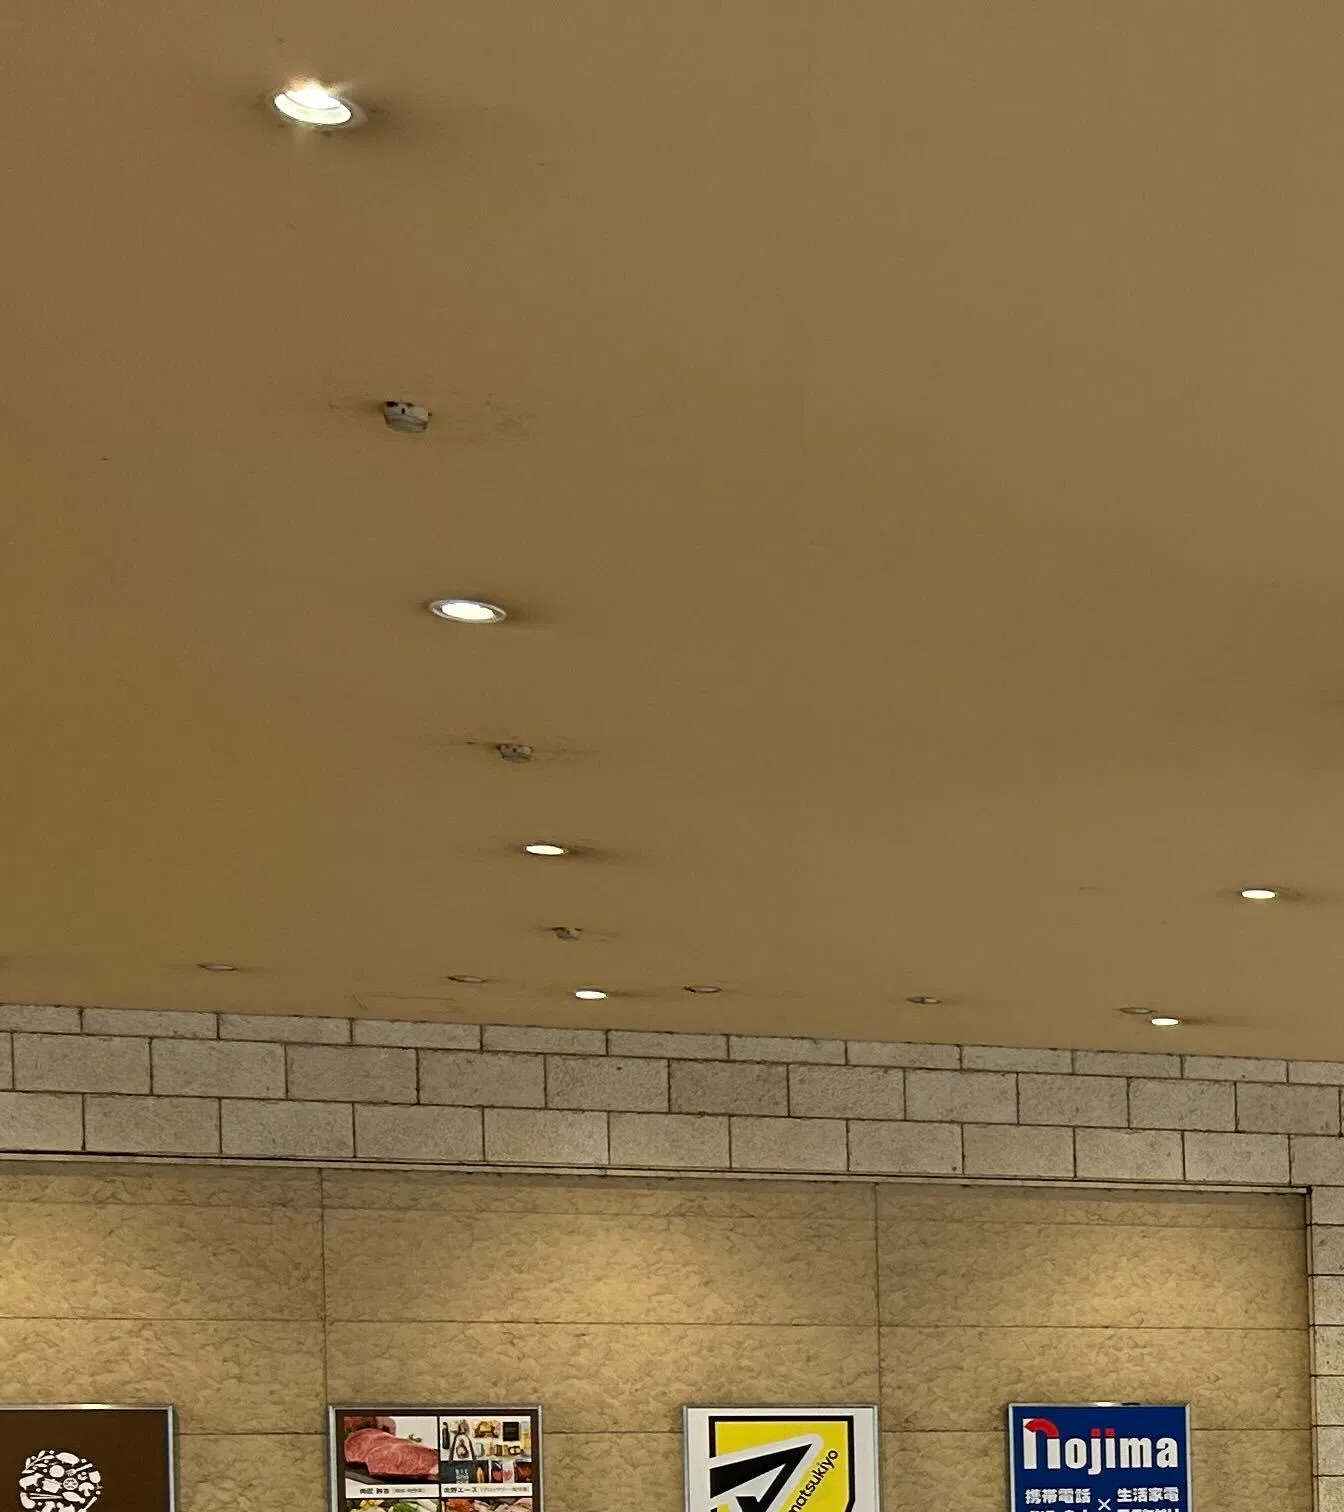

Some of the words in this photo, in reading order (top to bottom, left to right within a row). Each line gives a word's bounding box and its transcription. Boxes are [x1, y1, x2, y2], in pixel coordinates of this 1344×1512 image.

[1022, 1418, 1179, 1476] nojima
[1117, 1486, 1180, 1503] 生活家電
